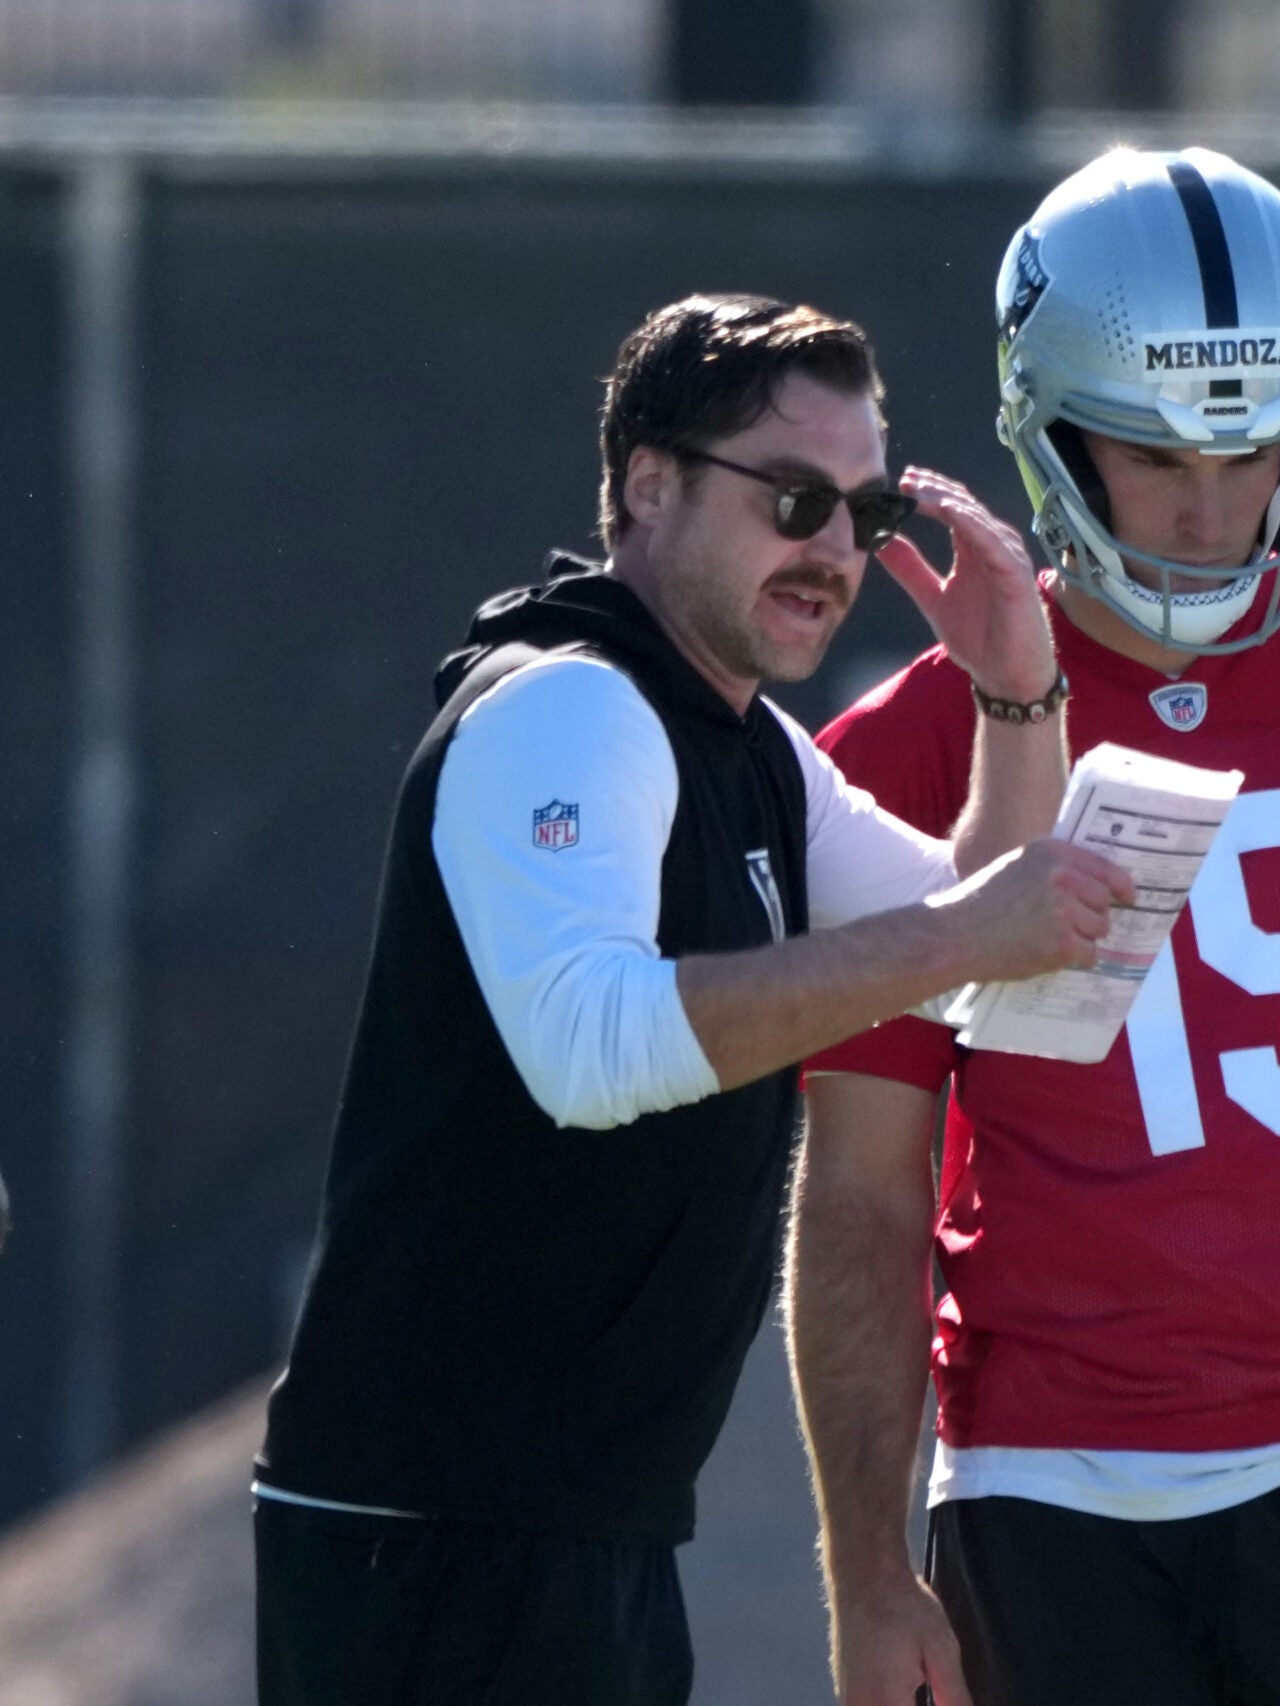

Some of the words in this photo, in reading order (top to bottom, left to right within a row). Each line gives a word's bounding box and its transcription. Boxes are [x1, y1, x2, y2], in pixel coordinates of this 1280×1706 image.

[1203, 405, 1249, 418] RAIDERS
[1172, 705, 1196, 723] NFL
[538, 821, 575, 846] NFL
